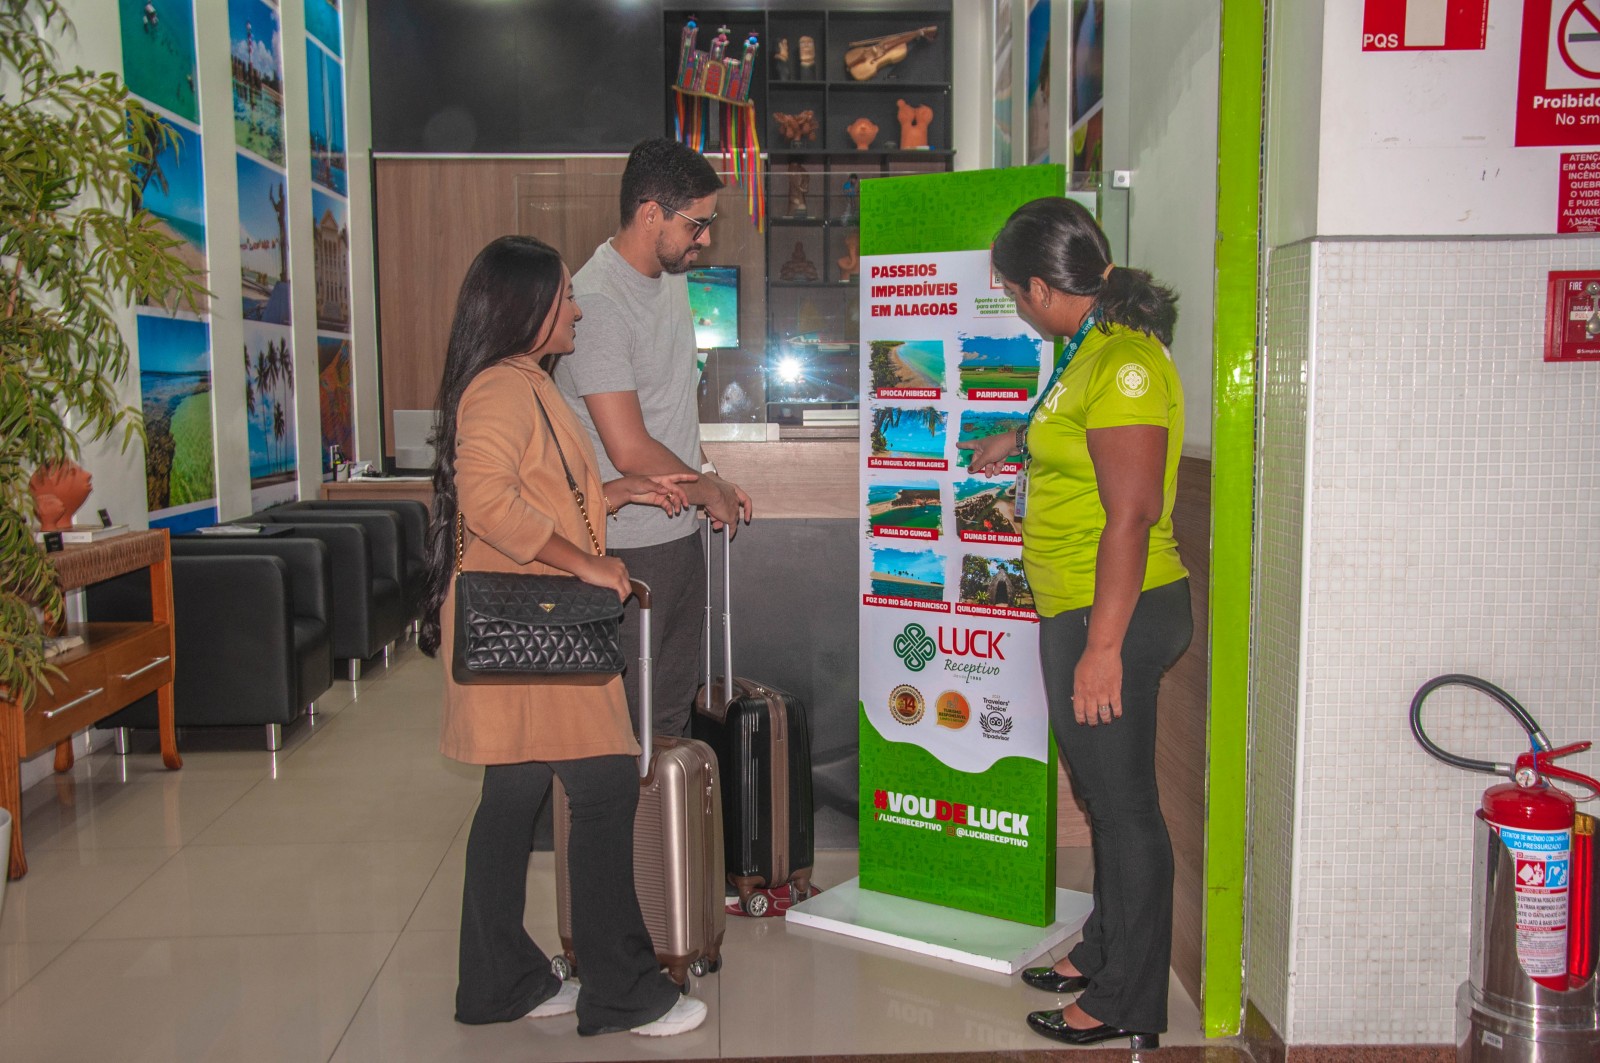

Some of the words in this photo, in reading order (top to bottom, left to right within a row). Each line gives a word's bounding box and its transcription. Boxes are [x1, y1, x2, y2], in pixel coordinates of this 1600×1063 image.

[1363, 33, 1399, 49] PQS
[1555, 113, 1576, 125] No
[1569, 154, 1600, 162] ATENÇ
[1563, 163, 1576, 171] EM
[1570, 190, 1578, 198] O
[1577, 199, 1600, 207] PUXE
[871, 263, 937, 279] PASSEIOS
[871, 281, 958, 298] IMPERDÍVEIS
[1569, 281, 1583, 291] FIRE
[871, 304, 892, 317] EM
[894, 302, 958, 317] ALAGOAS
[880, 389, 937, 398] IPIOCA/HIBISCUS
[976, 391, 1019, 399] PARIPUEIRA
[870, 458, 882, 466] SÃO
[904, 460, 916, 468] DOS
[917, 461, 945, 469] MILAGRES
[880, 528, 899, 537] PRAIA
[900, 529, 909, 537] DO
[909, 530, 932, 538] GUNGA
[964, 532, 987, 541] DUNAS
[865, 596, 878, 604] FOZ
[878, 597, 888, 605] DO
[888, 598, 899, 606] RIO
[900, 598, 913, 607] SÃO
[913, 600, 949, 611] FRANCISCO
[956, 606, 991, 615] QUILOMBO
[992, 608, 1006, 616] DOS
[1007, 609, 1038, 619] PALMAR
[938, 626, 1006, 661] LUCK
[944, 658, 1000, 684] Receptivo
[986, 704, 1007, 712] Choice
[982, 732, 1010, 741] Tripadvisor
[873, 789, 1029, 837] #VOUDELUCK
[956, 827, 1028, 848] @LUCKRECEPTIVO
